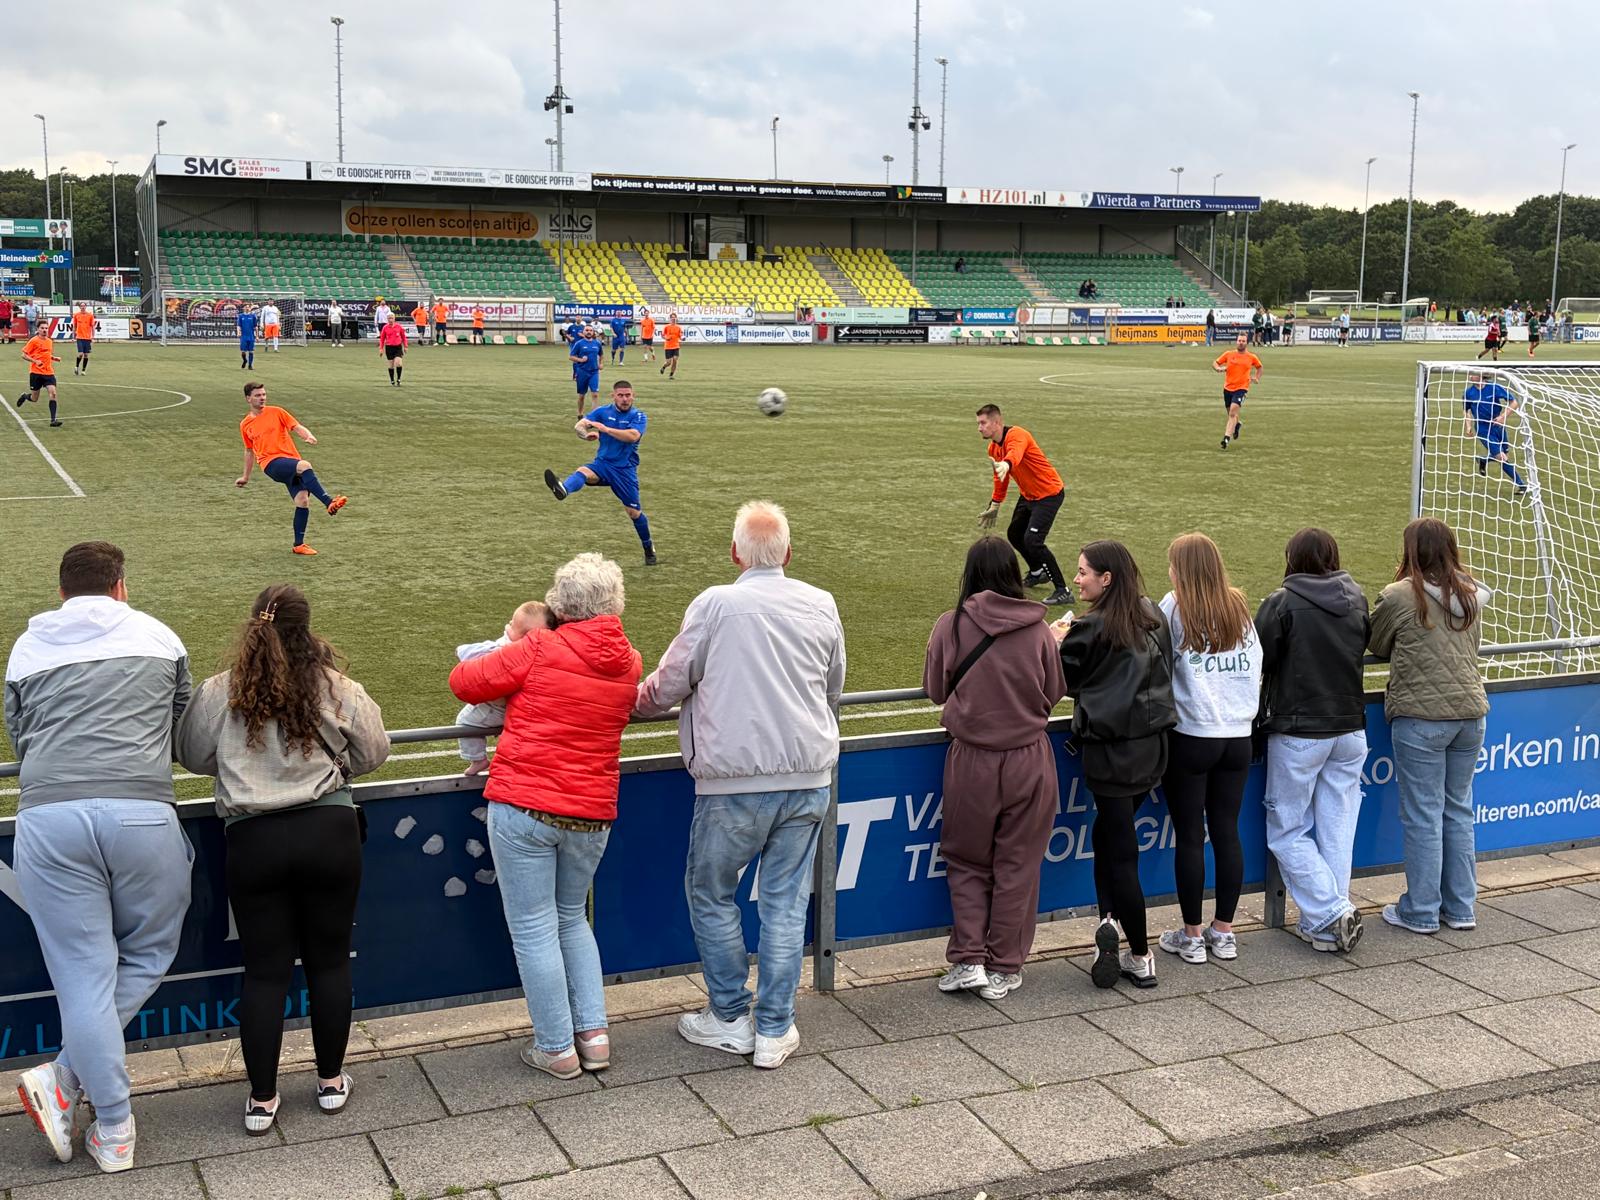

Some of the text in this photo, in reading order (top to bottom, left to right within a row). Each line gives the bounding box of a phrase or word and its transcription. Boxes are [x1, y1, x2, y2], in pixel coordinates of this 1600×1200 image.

[184, 157, 236, 176] SMG
[336, 167, 411, 180] DE GOOISCHE POFFER
[505, 174, 574, 186] DE GOOISCHE POFFER
[593, 178, 611, 187] Ook
[613, 179, 642, 189] tijdens
[643, 180, 654, 188] de
[656, 180, 695, 191] wedstrijd
[697, 184, 716, 193] gaat
[735, 184, 757, 193] werk
[759, 186, 791, 195] gewoon
[793, 186, 814, 195] door.
[816, 189, 887, 198] www.teeuwissen.com
[979, 189, 1046, 205] HZ101.nl
[1096, 193, 1137, 208] Wierda
[1153, 195, 1201, 209] Partners
[349, 211, 536, 235] Onze rollen scoren altijd.
[549, 213, 593, 232] KING
[0, 254, 37, 263] Heineken
[555, 304, 595, 315] Maxima
[698, 305, 739, 315] VERHAAL
[705, 329, 724, 337] Blok
[741, 329, 810, 339] Knipmeijer Blok
[1115, 327, 1158, 340] heijmans
[1474, 733, 1563, 774] erken
[1471, 789, 1600, 825] lteren.com/ca
